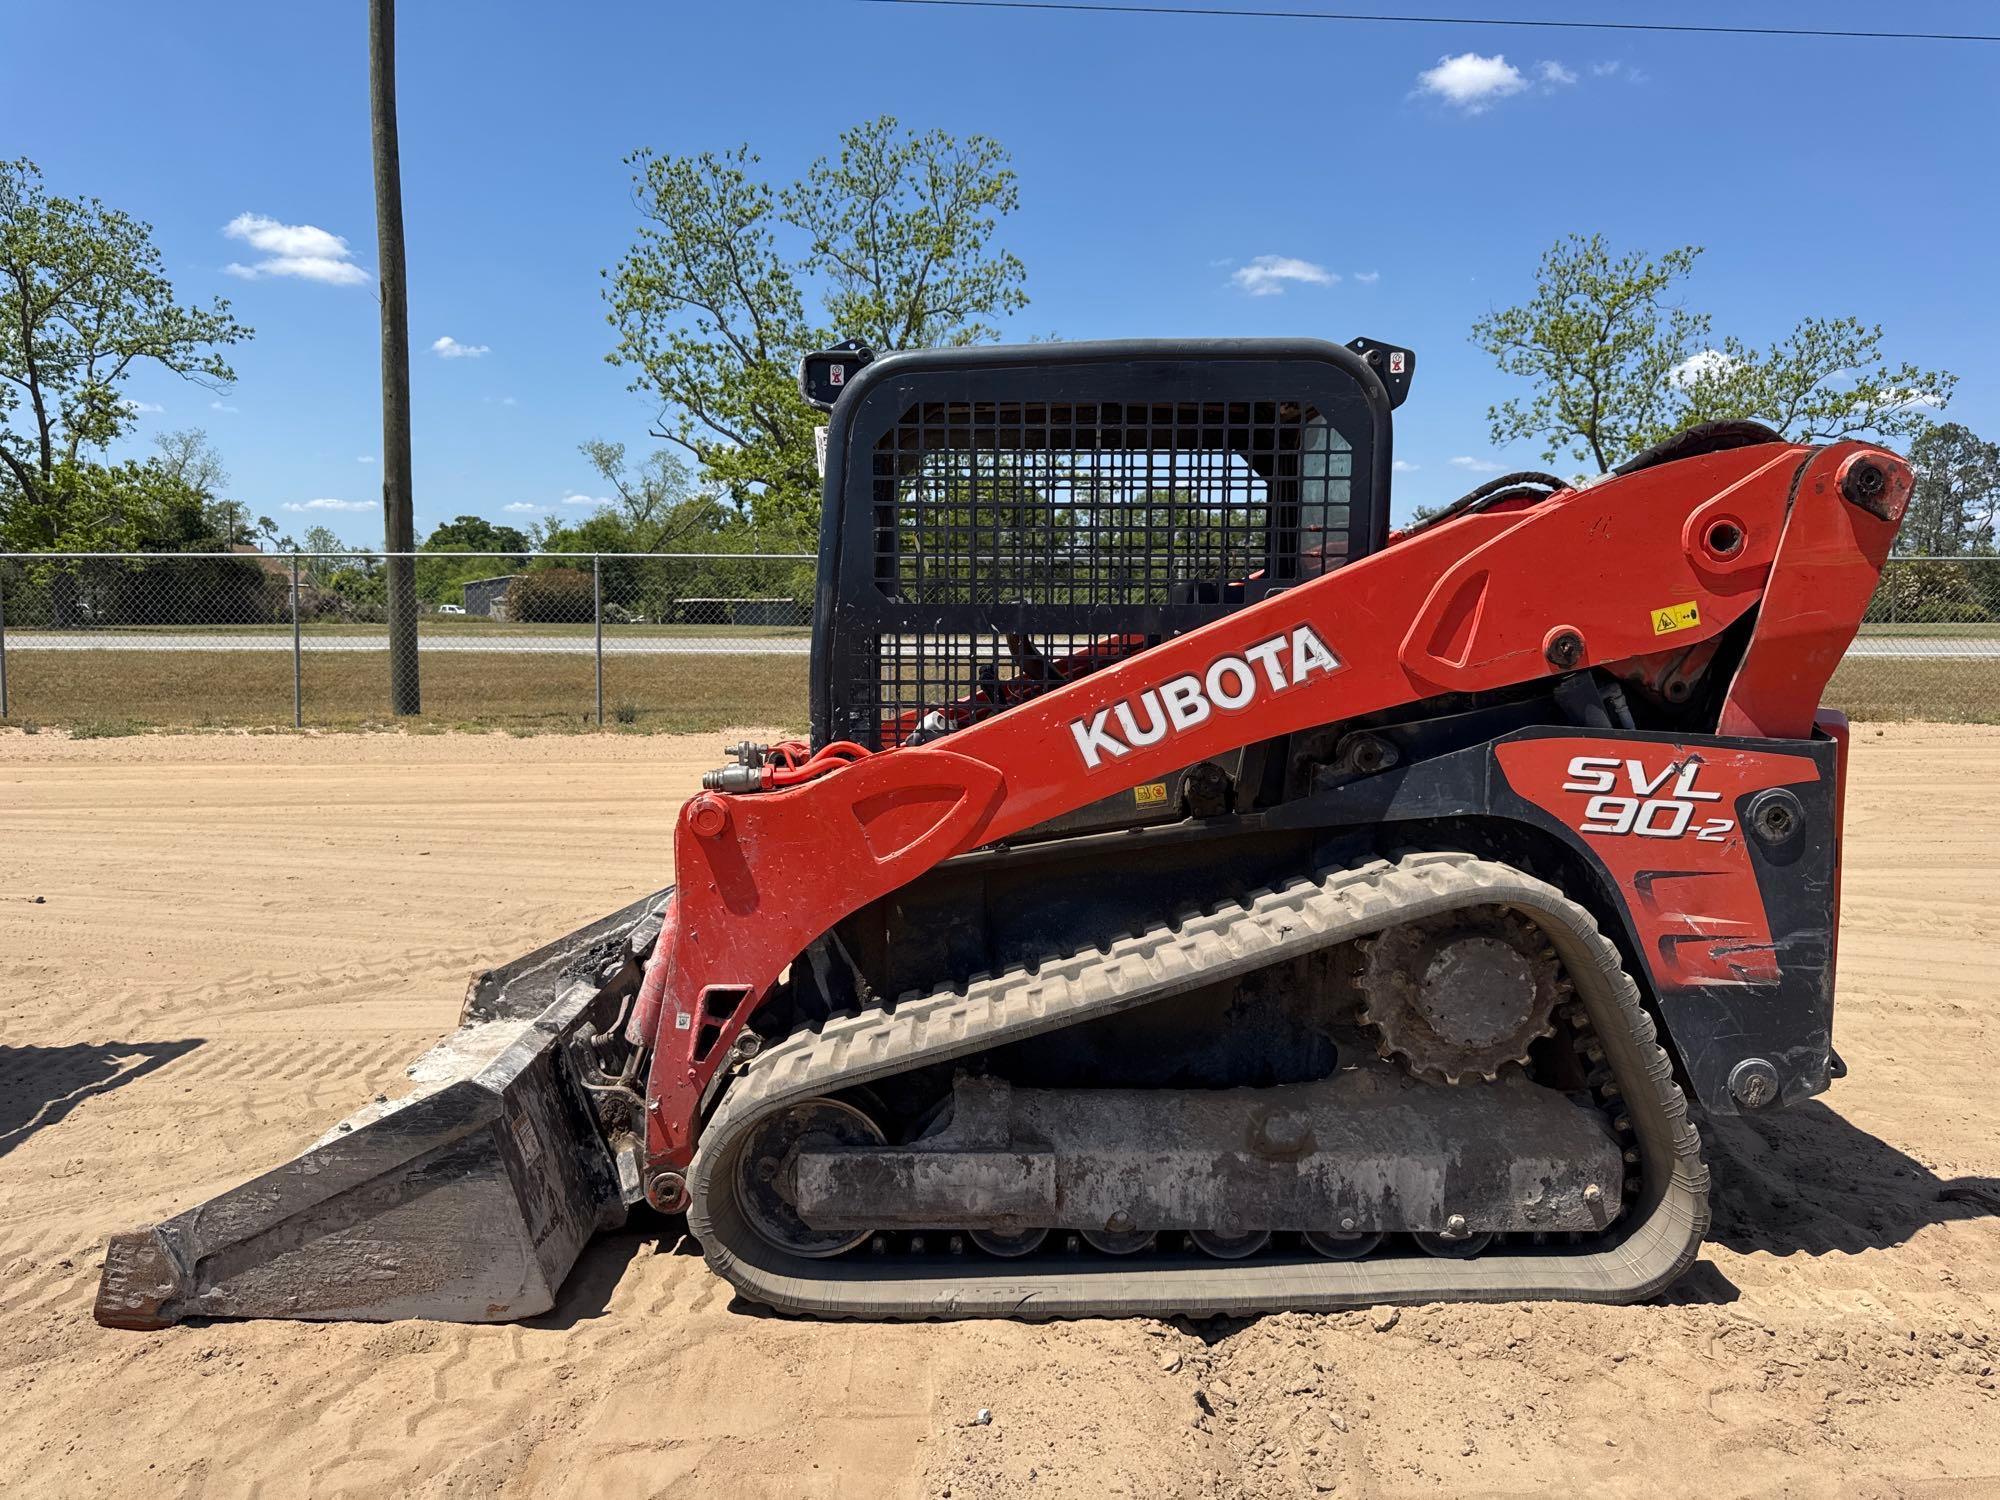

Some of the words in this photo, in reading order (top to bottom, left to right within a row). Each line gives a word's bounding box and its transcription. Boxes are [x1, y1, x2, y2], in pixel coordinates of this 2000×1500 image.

[1069, 626, 1341, 769] KUBOTA
[1562, 756, 1723, 801] SVL
[1579, 795, 1735, 842] 90-2
